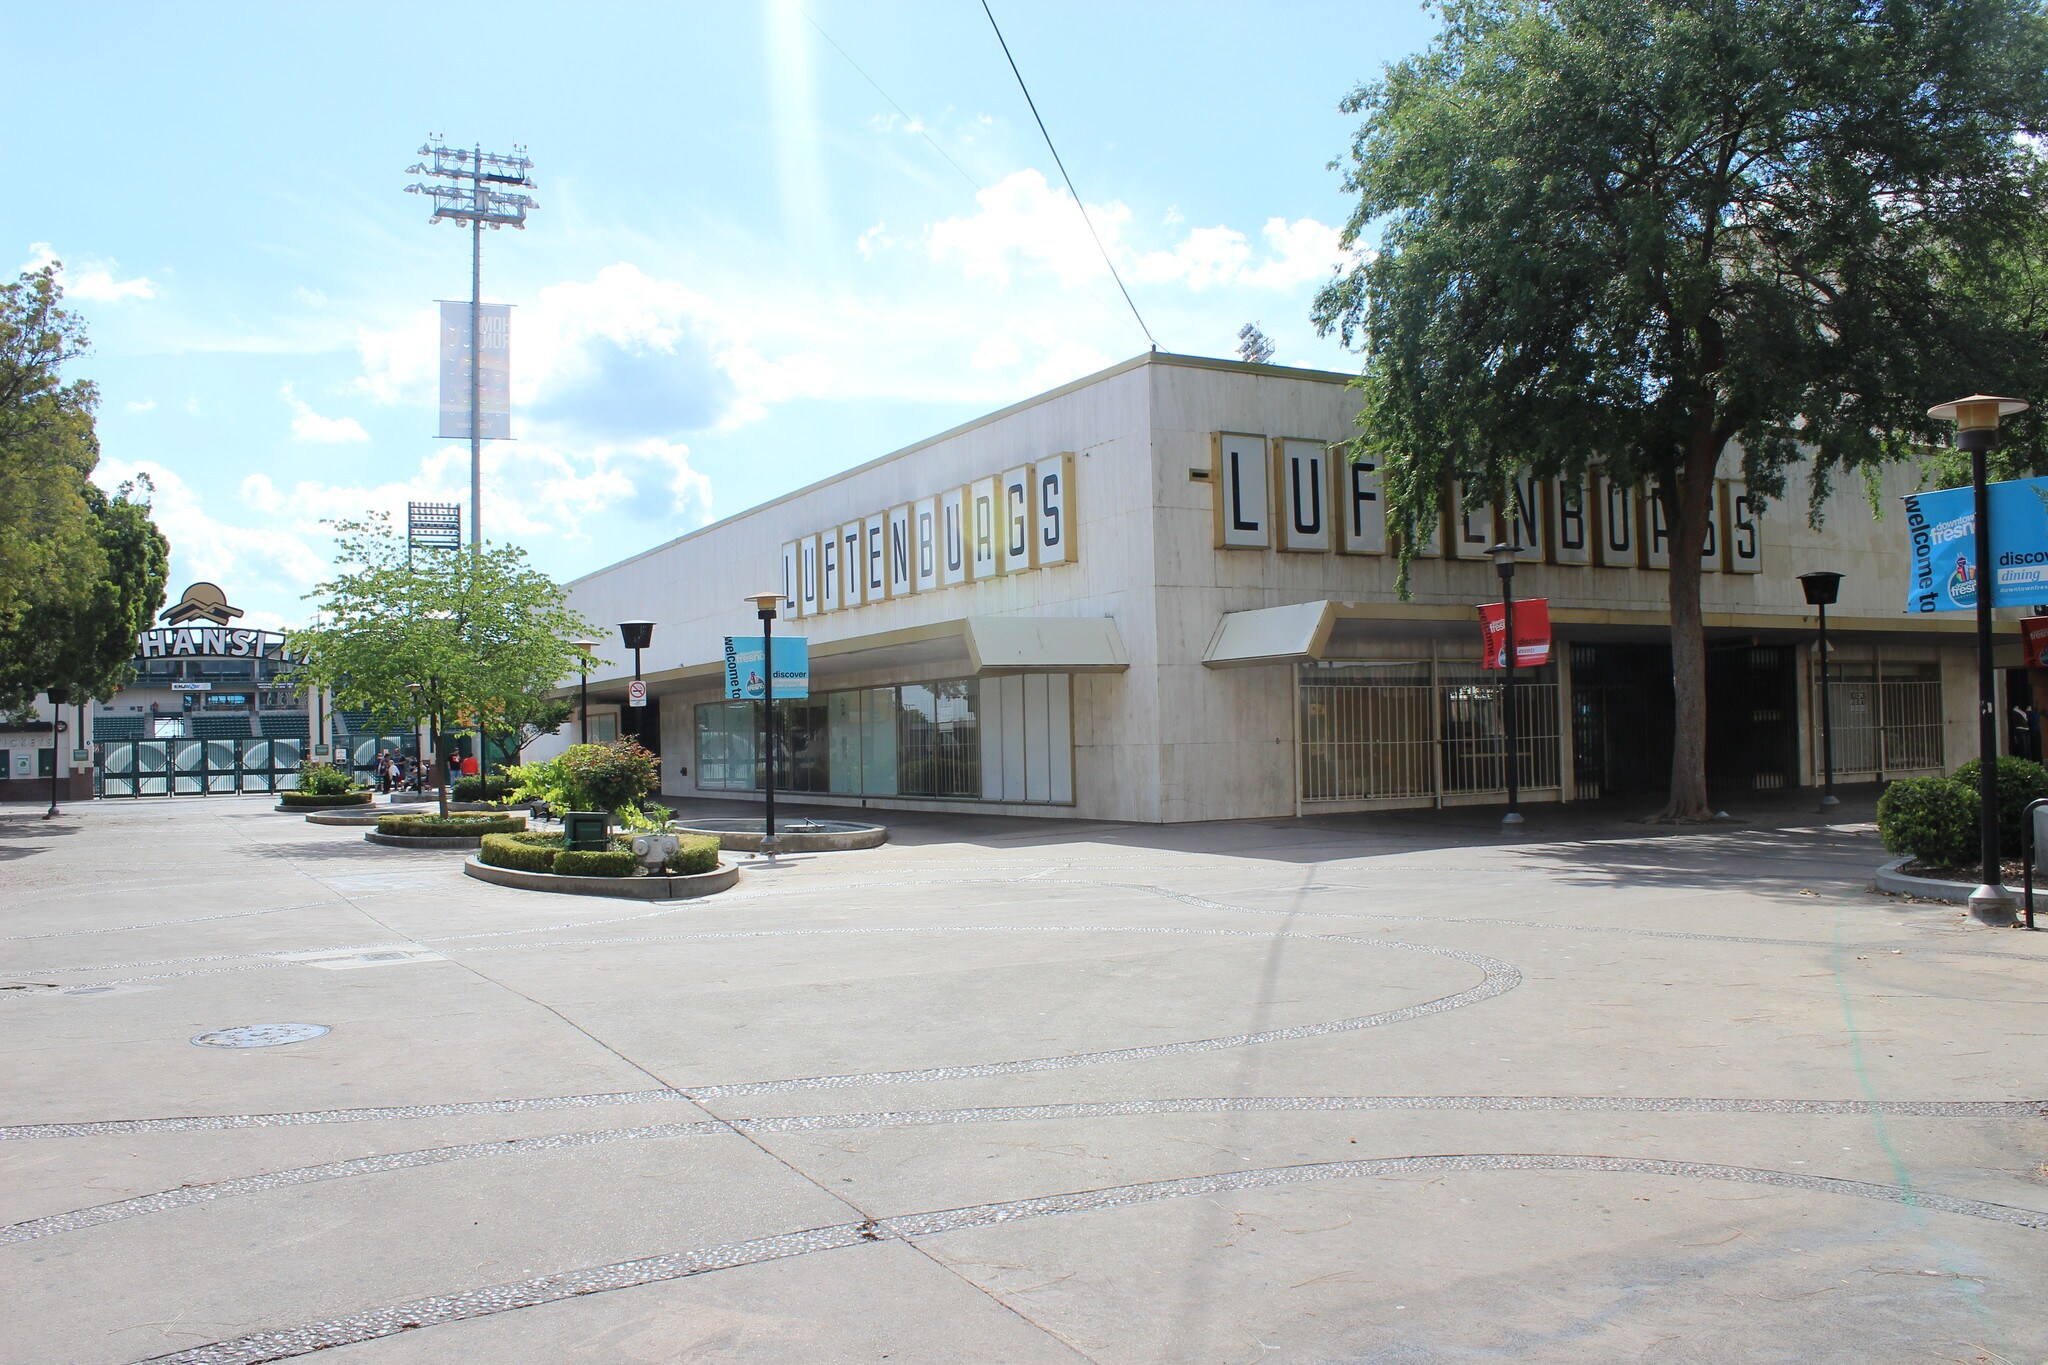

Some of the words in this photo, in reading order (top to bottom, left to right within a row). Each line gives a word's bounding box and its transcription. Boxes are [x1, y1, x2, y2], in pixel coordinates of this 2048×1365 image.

[1231, 452, 1756, 560] LUFENBUS
[1930, 522, 1976, 546] fresn
[1936, 512, 1977, 532] downtow
[1904, 495, 1933, 590] welcome
[1919, 591, 1939, 614] to
[2001, 569, 2041, 581] dining
[139, 628, 267, 658] HANSI
[724, 636, 740, 687] welcome
[732, 688, 741, 698] to
[736, 653, 764, 663] fresno
[3, 738, 53, 748] ICKETS
